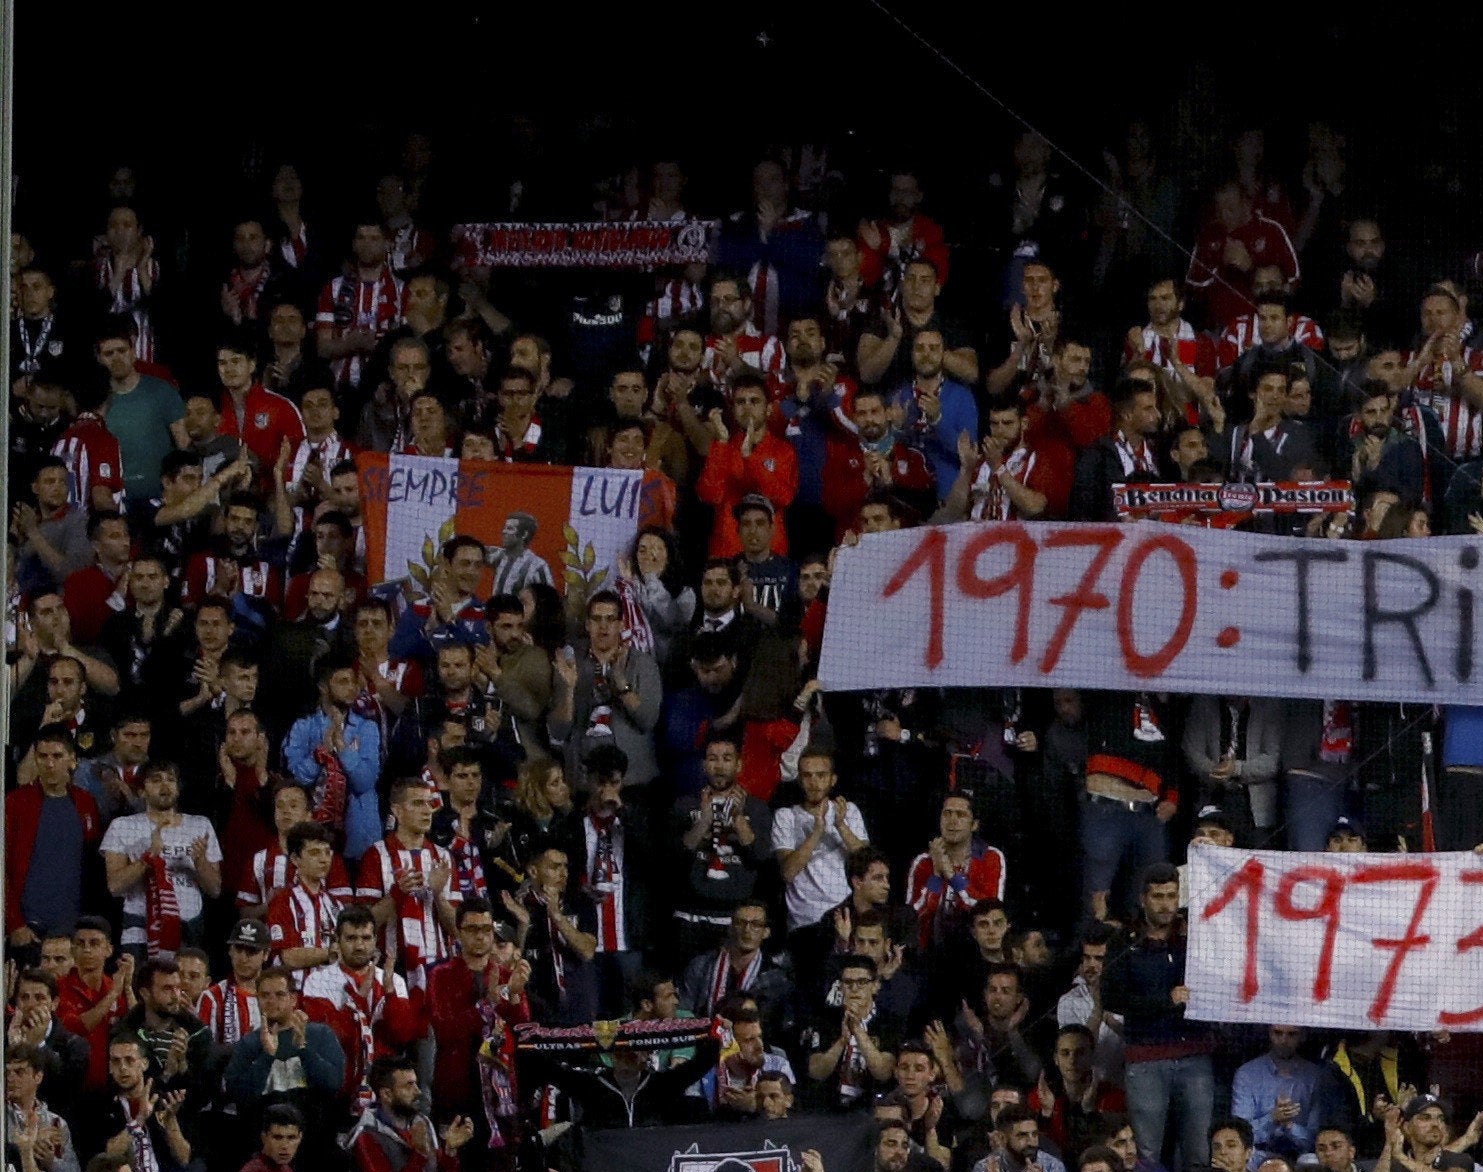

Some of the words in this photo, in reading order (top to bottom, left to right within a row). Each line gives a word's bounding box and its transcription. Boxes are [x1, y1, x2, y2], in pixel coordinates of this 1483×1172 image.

[362, 466, 490, 508] SIEMPRE
[578, 474, 664, 523] LUIS
[882, 524, 1241, 679] 1970:
